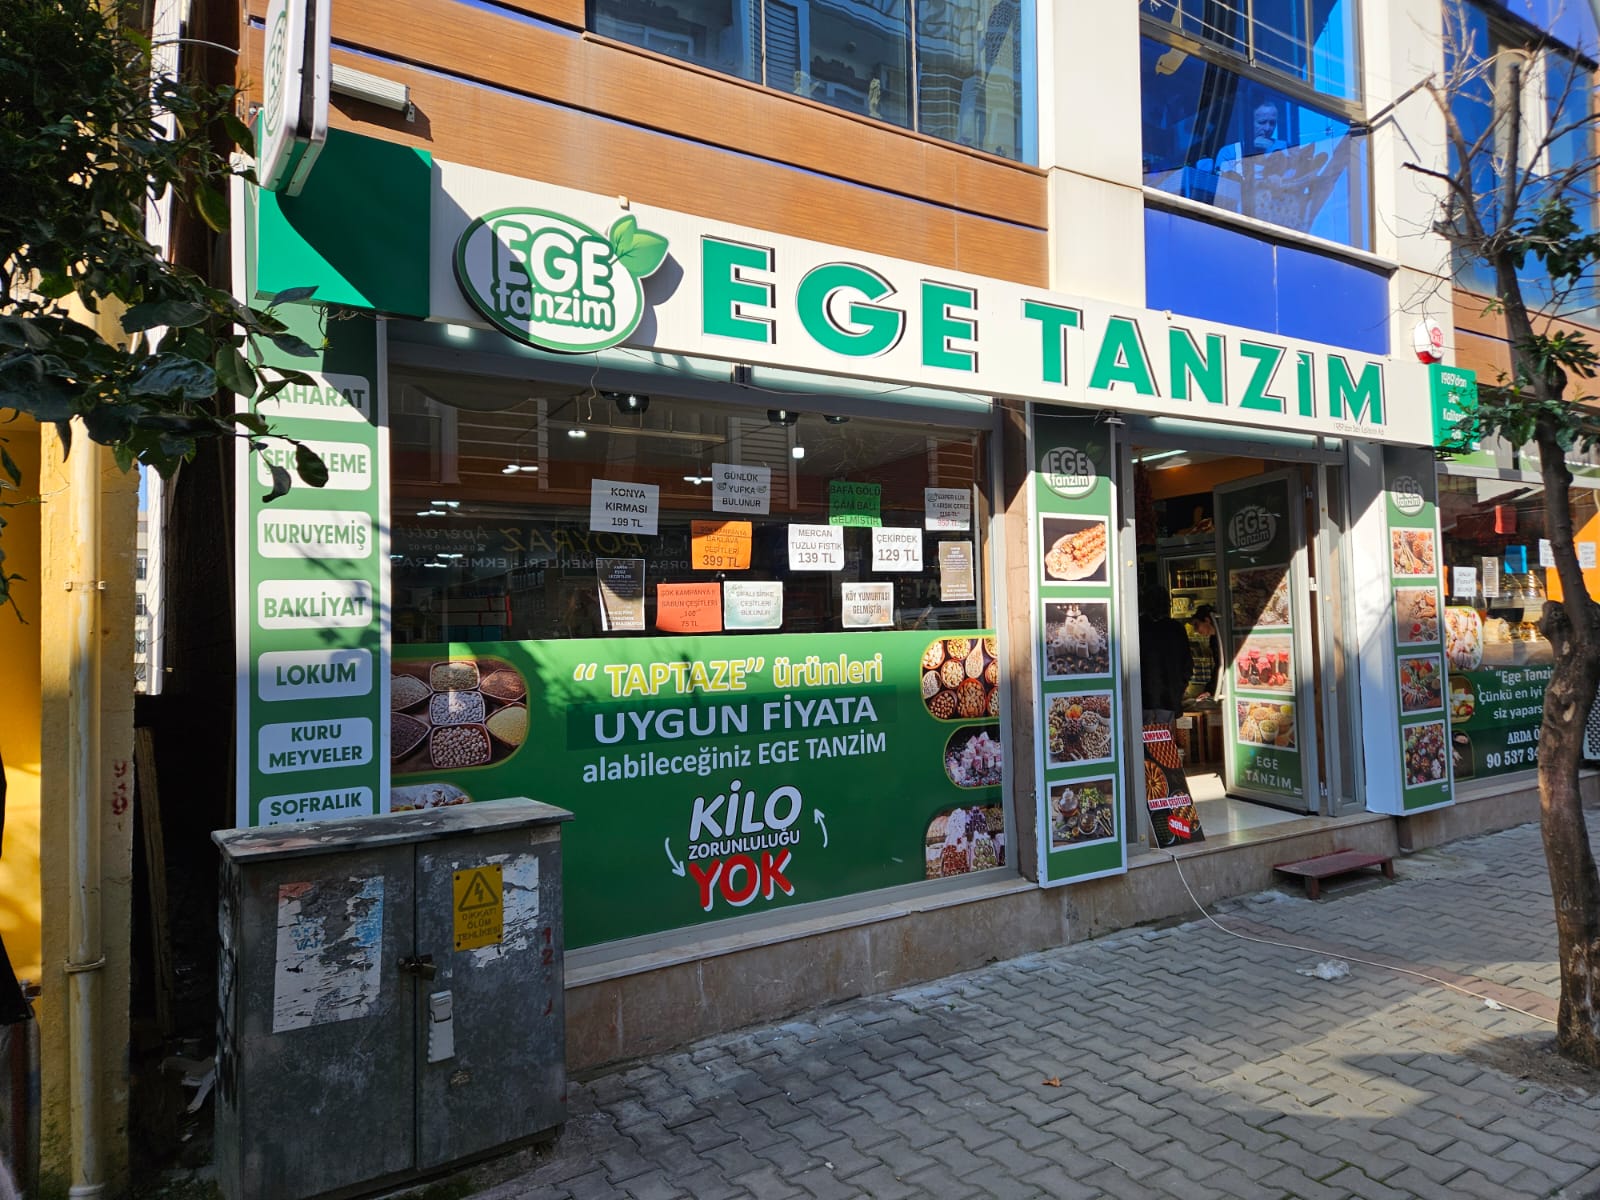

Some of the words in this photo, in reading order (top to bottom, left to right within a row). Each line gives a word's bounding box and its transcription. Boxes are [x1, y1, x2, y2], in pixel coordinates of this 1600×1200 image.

[497, 224, 611, 299] EGE
[496, 280, 612, 328] tanzim
[700, 233, 980, 373] EGE
[270, 383, 365, 409] AHARAT
[263, 449, 366, 475] ŞEKEME
[1050, 451, 1088, 475] EGE
[723, 471, 758, 482] GÜNLÜK
[1050, 473, 1090, 488] tanzim
[610, 487, 646, 499] KONYA
[728, 484, 756, 494] YUFKA
[605, 501, 648, 514] KIRMASI
[722, 497, 761, 508] BULUNUR
[611, 517, 629, 527] 199
[631, 518, 644, 528] TL
[1235, 510, 1270, 537] EGE
[263, 520, 366, 550] KURUYEMİŞ
[798, 529, 833, 538] MERCAN
[876, 533, 918, 544] ÇEKİRDEK
[1238, 530, 1270, 546] tanzim
[791, 541, 817, 550] TUZLU
[878, 549, 900, 561] 129
[903, 549, 919, 562] TL
[703, 554, 724, 567] 399
[727, 556, 741, 568] TL
[798, 552, 819, 563] 139
[821, 553, 836, 564] TL
[263, 592, 366, 618] BAKLİYAT
[276, 662, 357, 686] LOKUM
[772, 652, 883, 688] ürünleri
[1478, 688, 1513, 705] Çünkü
[1514, 689, 1528, 700] en
[1530, 685, 1542, 699] iyi
[594, 703, 749, 744] UYGUN
[762, 694, 879, 732] FİYATA
[1493, 707, 1508, 719] siz
[1509, 705, 1543, 720] yapars
[291, 723, 342, 742] KURU
[1507, 730, 1533, 745] ARDA
[269, 745, 362, 768] MEYVELER
[582, 745, 751, 783] alabileceğiniz
[757, 740, 801, 765] EGE
[804, 729, 887, 760] TANZİM
[1256, 755, 1279, 770] EGE
[1486, 752, 1501, 768] 90
[1504, 748, 1525, 766] 537
[270, 792, 363, 817] SOFRALIK
[688, 779, 803, 842] KİLO
[688, 827, 801, 861] ZORUNLULUĞU
[688, 848, 796, 912] YOK
[467, 918, 492, 930] ÖLÜM
